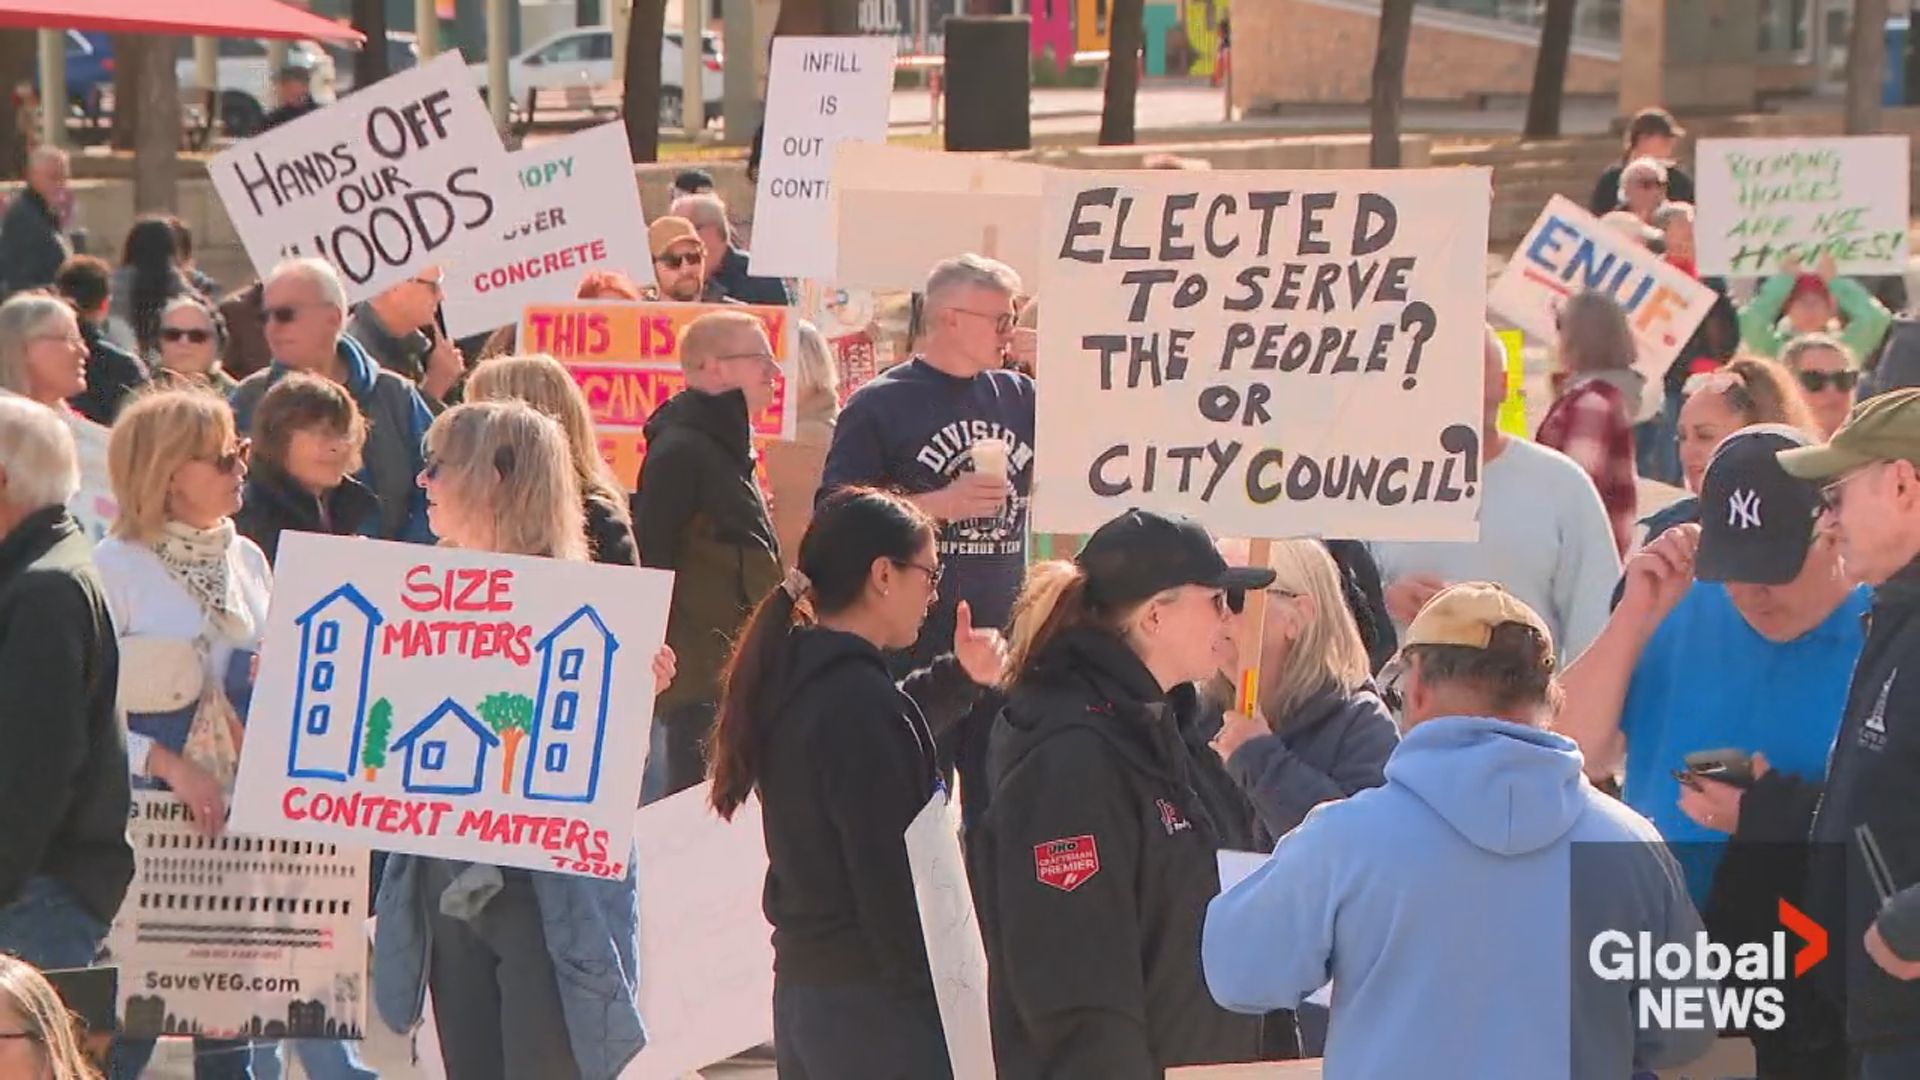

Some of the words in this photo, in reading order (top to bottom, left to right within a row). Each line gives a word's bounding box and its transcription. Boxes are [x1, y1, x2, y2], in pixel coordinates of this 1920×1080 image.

[803, 52, 862, 73] INFILL
[819, 96, 838, 115] IS
[234, 144, 357, 216] HANDS
[367, 90, 452, 159] OFF
[783, 137, 824, 157] OUT
[337, 166, 412, 214] OUR
[519, 156, 574, 189] OPY
[770, 178, 830, 199] CONT
[1059, 187, 1398, 262] ELECTED
[474, 239, 607, 292] CONCRETE
[1121, 269, 1209, 322] TO
[1223, 257, 1417, 312] SERVE
[530, 312, 610, 358] THIS
[640, 315, 675, 358] IS
[1082, 329, 1195, 390] THE
[1219, 301, 1437, 390] PEOPLE?
[1198, 383, 1272, 426] OR
[1088, 439, 1243, 502] CITY
[1245, 425, 1479, 506] COUNCIL?
[400, 565, 514, 612] SIZE
[381, 620, 532, 667] MATTERS
[282, 786, 453, 836] CONTEXT
[457, 809, 609, 862] MATTERS
[550, 855, 624, 881] TOO!
[1039, 858, 1095, 877] PREMIER
[145, 971, 300, 993] SaveYEG.com
